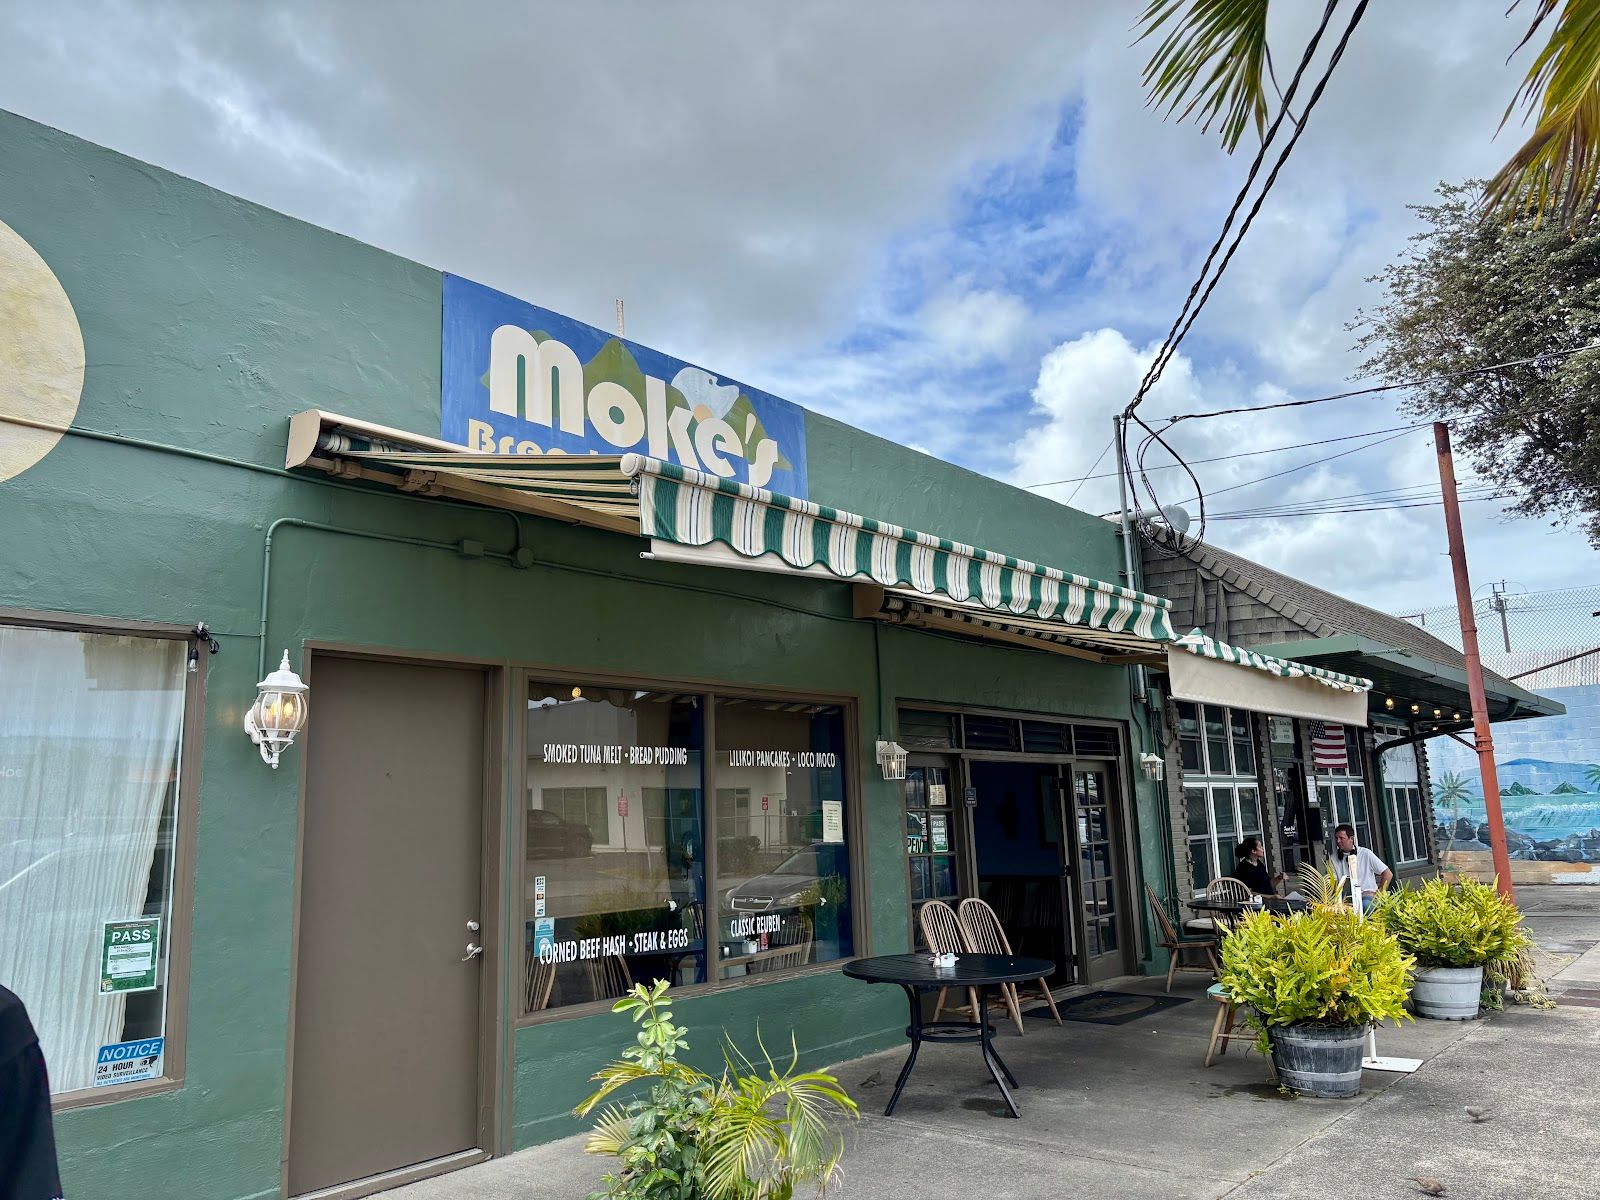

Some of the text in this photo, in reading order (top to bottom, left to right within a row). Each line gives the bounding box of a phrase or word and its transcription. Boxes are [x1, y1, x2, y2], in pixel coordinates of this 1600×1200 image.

[543, 744, 688, 766] SMOKED TUNA MELT BREAD PUDDING
[729, 750, 836, 768] LILIKOI PANCAKES LOCO MOCO
[907, 837, 923, 853] PEN
[731, 914, 781, 938] CLASSIC REUBEN
[112, 929, 151, 942] PASS
[539, 928, 689, 965] CORNED BEEF HASH STEAK & EGGS
[101, 1041, 160, 1061] NOTICE
[98, 1061, 134, 1073] 24 HOUR
[113, 1067, 148, 1077] SURVEILLANCE
